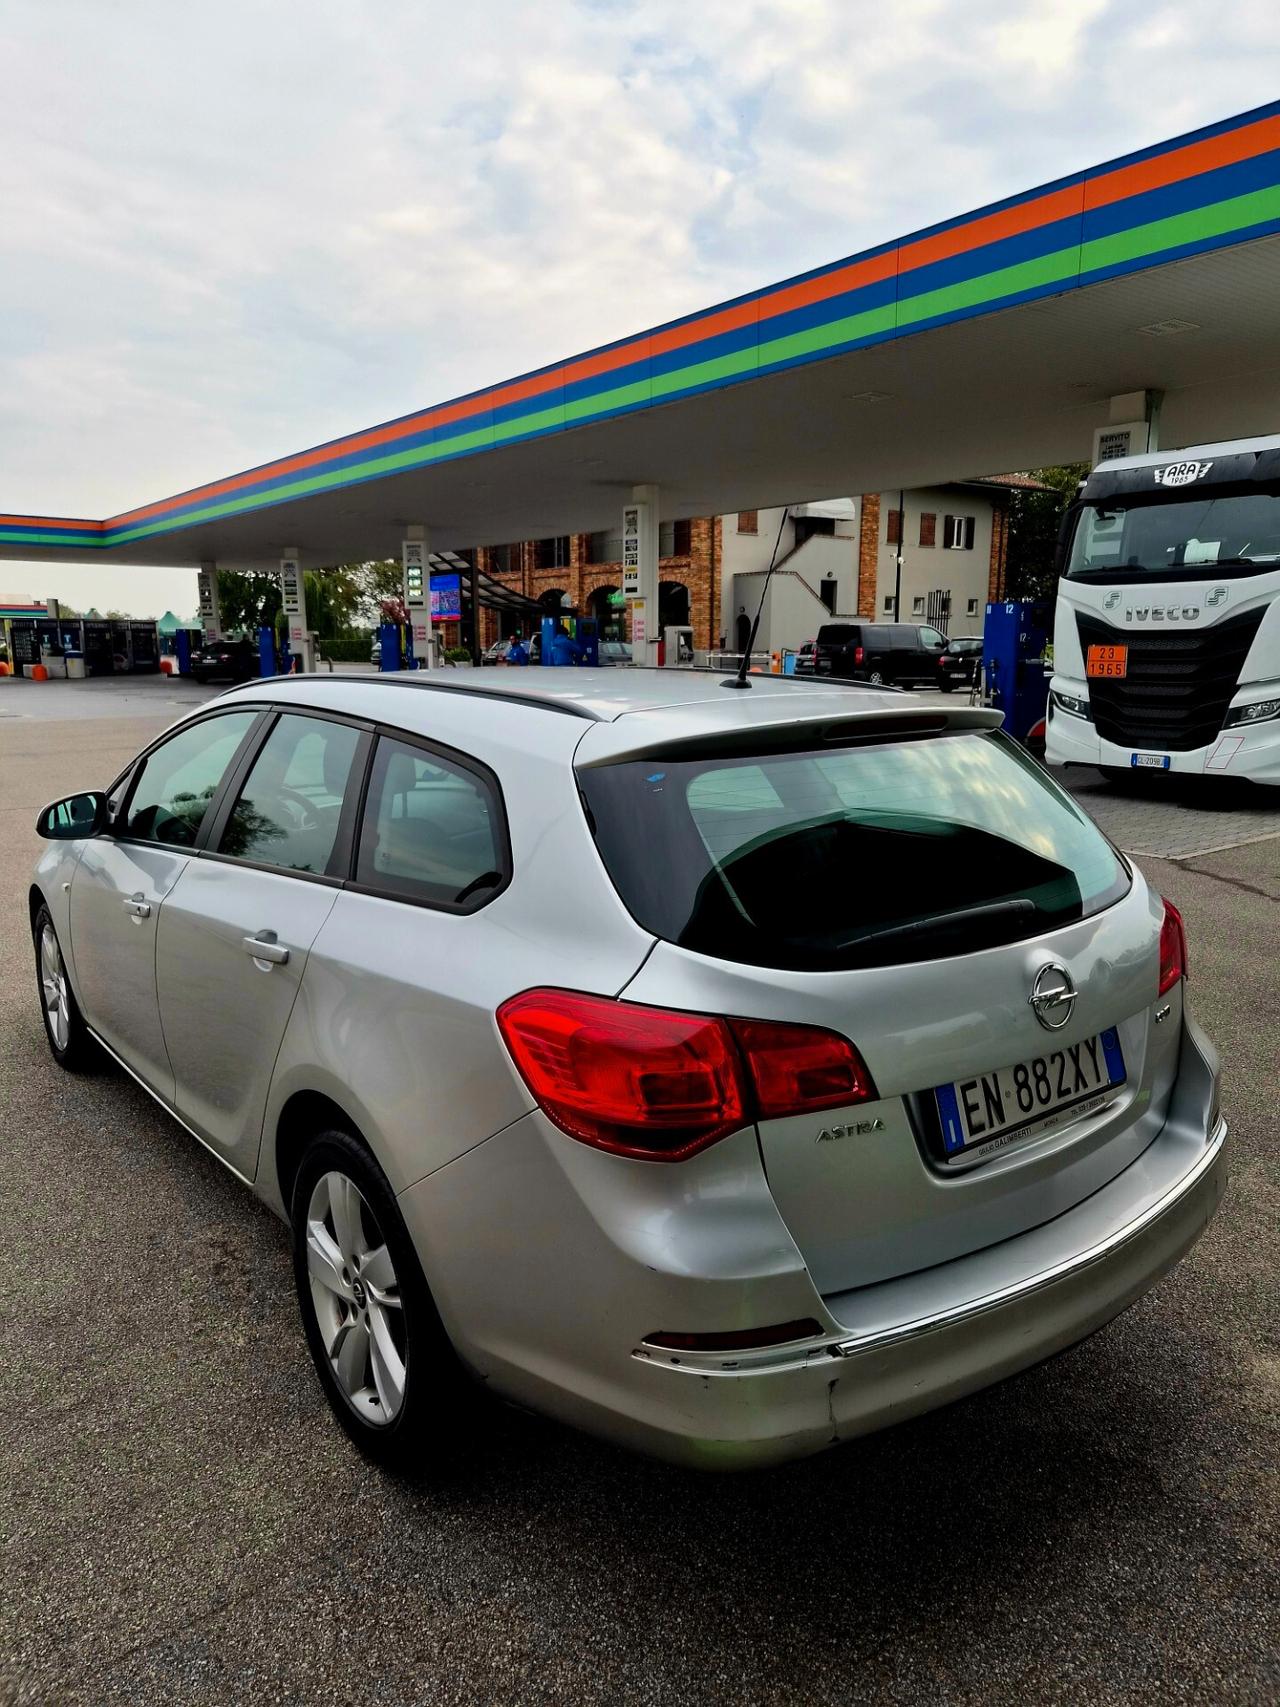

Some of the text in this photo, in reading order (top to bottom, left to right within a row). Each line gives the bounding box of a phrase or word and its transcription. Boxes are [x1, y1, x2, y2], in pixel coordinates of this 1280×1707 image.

[1100, 432, 1130, 443] SERVITO
[1167, 463, 1196, 477] ARA
[1005, 604, 1014, 614] 12
[1125, 605, 1200, 622] IVECO
[1099, 647, 1115, 659] 23
[1090, 663, 1122, 675] 1965
[959, 1035, 1103, 1137] EN 882XY
[815, 1119, 885, 1143] ASTRA
[994, 1127, 1032, 1147] GALIMBERTI
